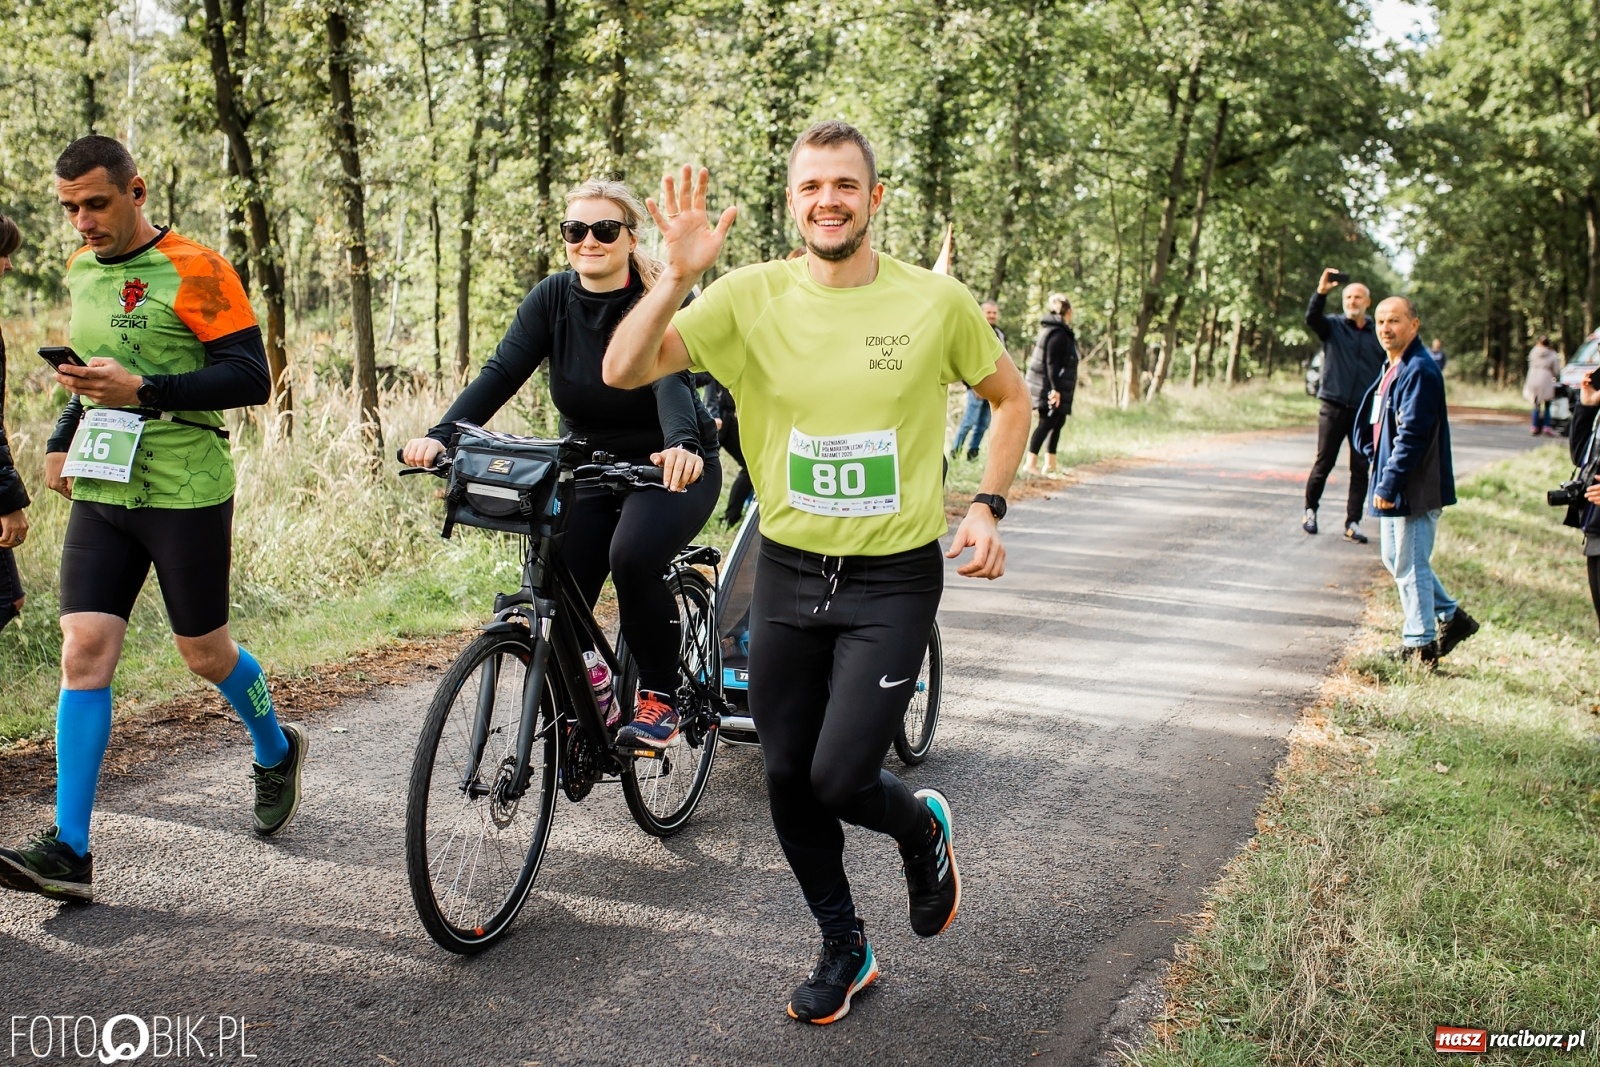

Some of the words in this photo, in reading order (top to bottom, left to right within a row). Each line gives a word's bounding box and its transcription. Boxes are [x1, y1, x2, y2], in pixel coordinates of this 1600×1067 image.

[111, 319, 147, 329] DZIKI
[865, 335, 910, 346] IZBICKO
[881, 347, 893, 357] W
[869, 358, 903, 371] BIEGU
[79, 431, 113, 460] 46
[811, 440, 821, 457] V
[812, 462, 866, 496] 80
